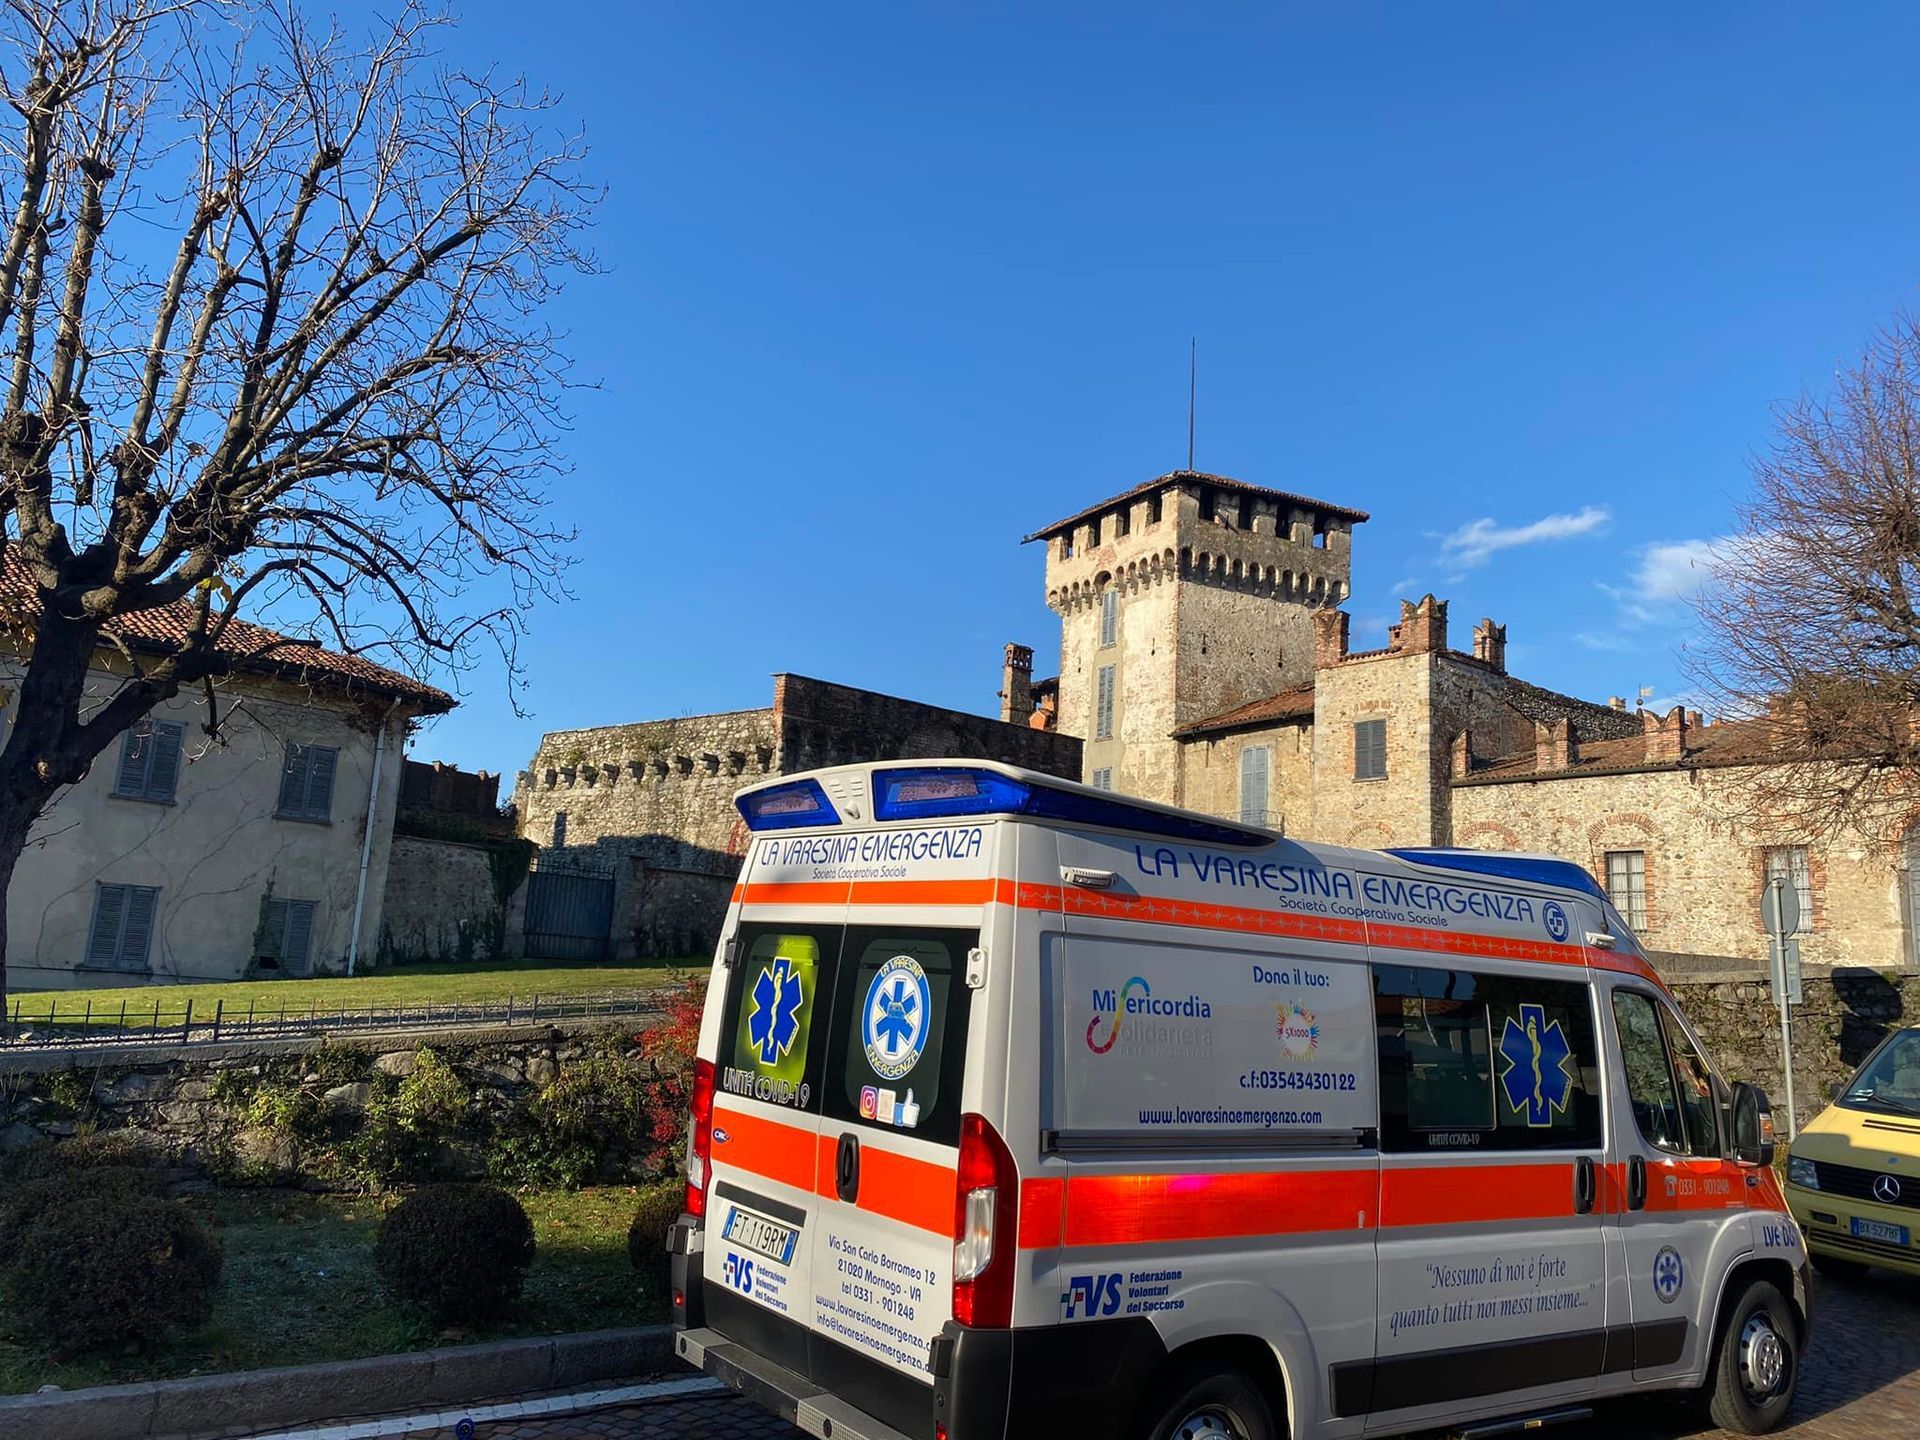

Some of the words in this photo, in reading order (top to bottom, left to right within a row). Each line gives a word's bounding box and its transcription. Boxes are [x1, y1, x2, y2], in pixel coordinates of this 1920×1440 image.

[761, 841, 779, 866] LA
[782, 836, 858, 864] VARESINA
[861, 828, 982, 862] EMERGENZA
[838, 866, 879, 879] Cooperativa
[880, 865, 907, 878] Sociale
[1135, 845, 1180, 878] LA
[1187, 851, 1354, 900] VARESINA
[1362, 882, 1535, 924] EMERGENZA
[1279, 895, 1328, 913] Società
[1331, 901, 1406, 922] Cooperativa
[1408, 911, 1449, 927] Sociale
[1252, 965, 1290, 985] Dona
[1293, 967, 1301, 986] il
[1305, 970, 1331, 988] tuo:
[866, 1043, 920, 1077] EMERGENZA
[754, 1075, 811, 1109] COVID-19
[1139, 1106, 1323, 1128] www.lavaresinaemergenza.com
[724, 1252, 754, 1294] FVS
[829, 1234, 841, 1250] Via
[842, 1240, 857, 1257] San
[858, 1246, 879, 1264] Carlo
[880, 1254, 922, 1281] Borromeo
[925, 1269, 936, 1286] 12
[1130, 1270, 1183, 1284] Federazione
[1489, 1257, 1502, 1284] di
[1506, 1259, 1525, 1281] noi
[1528, 1261, 1535, 1280] è
[1535, 1254, 1567, 1288] forte
[837, 1258, 863, 1279] 21020
[864, 1268, 902, 1296] Mornago
[909, 1285, 922, 1303] VA
[1063, 1272, 1123, 1319] FVS
[1128, 1285, 1169, 1299] Volontari
[841, 1281, 852, 1296] tel
[853, 1285, 873, 1305] 0331
[881, 1296, 915, 1321] 901248
[1126, 1300, 1141, 1314] del
[1142, 1299, 1185, 1312] Soccorso
[1390, 1304, 1439, 1337] quanto
[1443, 1297, 1473, 1325] tutti
[1476, 1295, 1497, 1318] noi
[1500, 1291, 1534, 1317] messi
[815, 1294, 931, 1353] www.lavaresinaemergenza.c
[816, 1311, 932, 1374] info@lavaresinaemergenza.c
